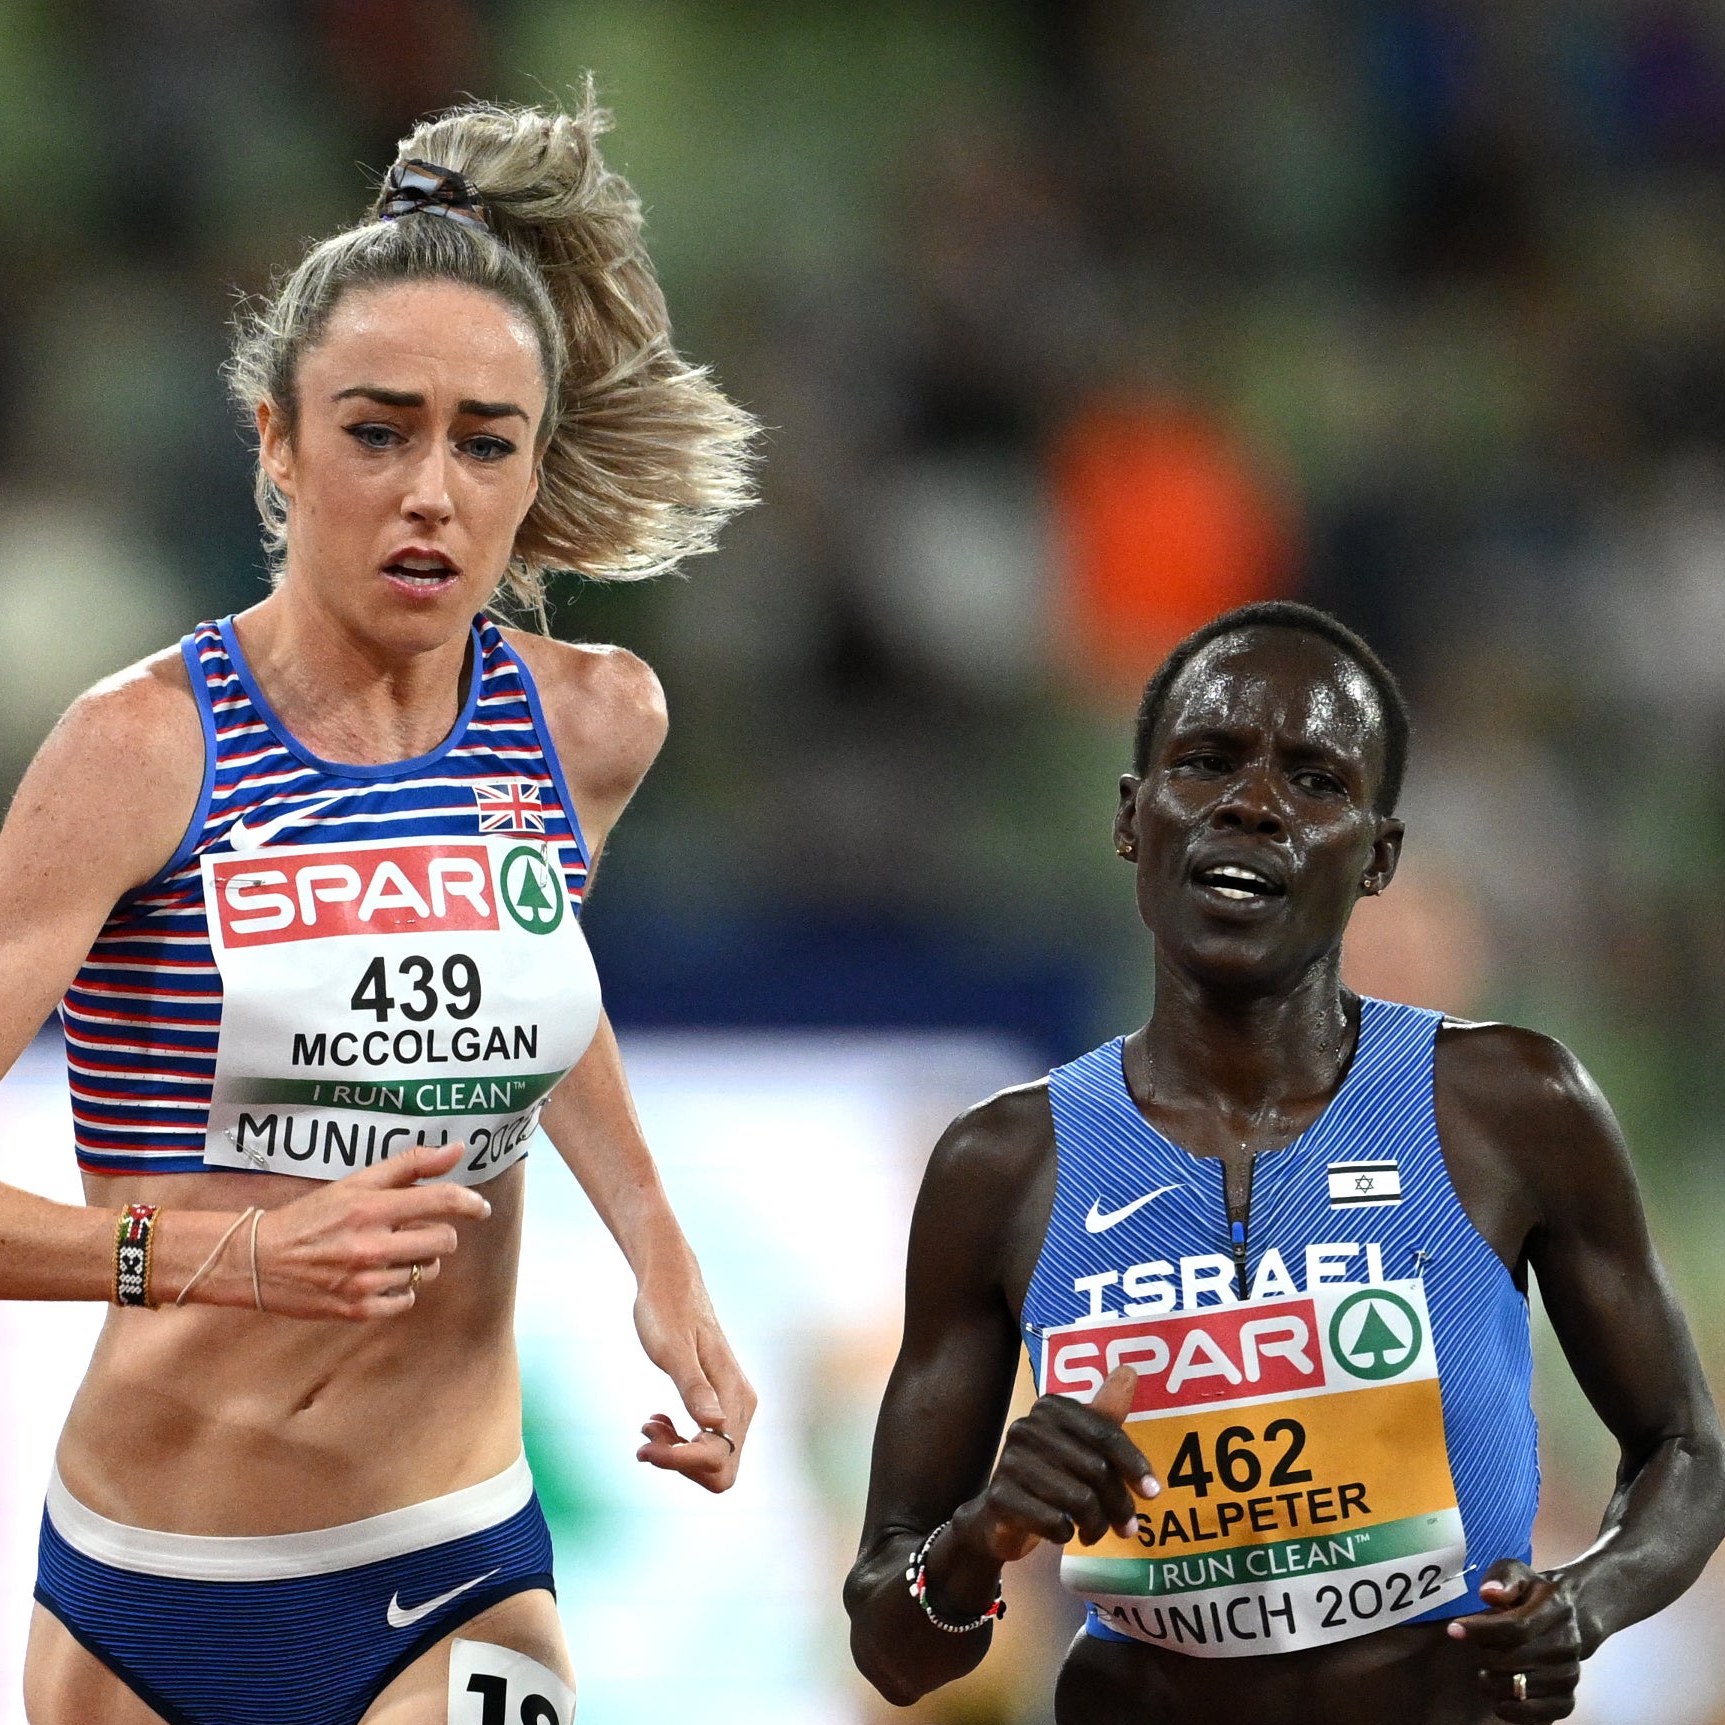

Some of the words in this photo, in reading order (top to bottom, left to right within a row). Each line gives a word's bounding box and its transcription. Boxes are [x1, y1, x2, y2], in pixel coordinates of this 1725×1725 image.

[223, 859, 491, 934] SPAR
[350, 953, 483, 1023] 439
[291, 1024, 538, 1066] MCCOLGAN
[312, 1085, 321, 1101] I
[332, 1085, 405, 1109] RUN
[1054, 1315, 1314, 1402] SPAR
[1166, 1419, 1313, 1498] 462
[1136, 1481, 1372, 1547] SALPETER
[1148, 1563, 1156, 1591] I
[1163, 1555, 1236, 1590] RUN
[1315, 1564, 1443, 1628] 2022
